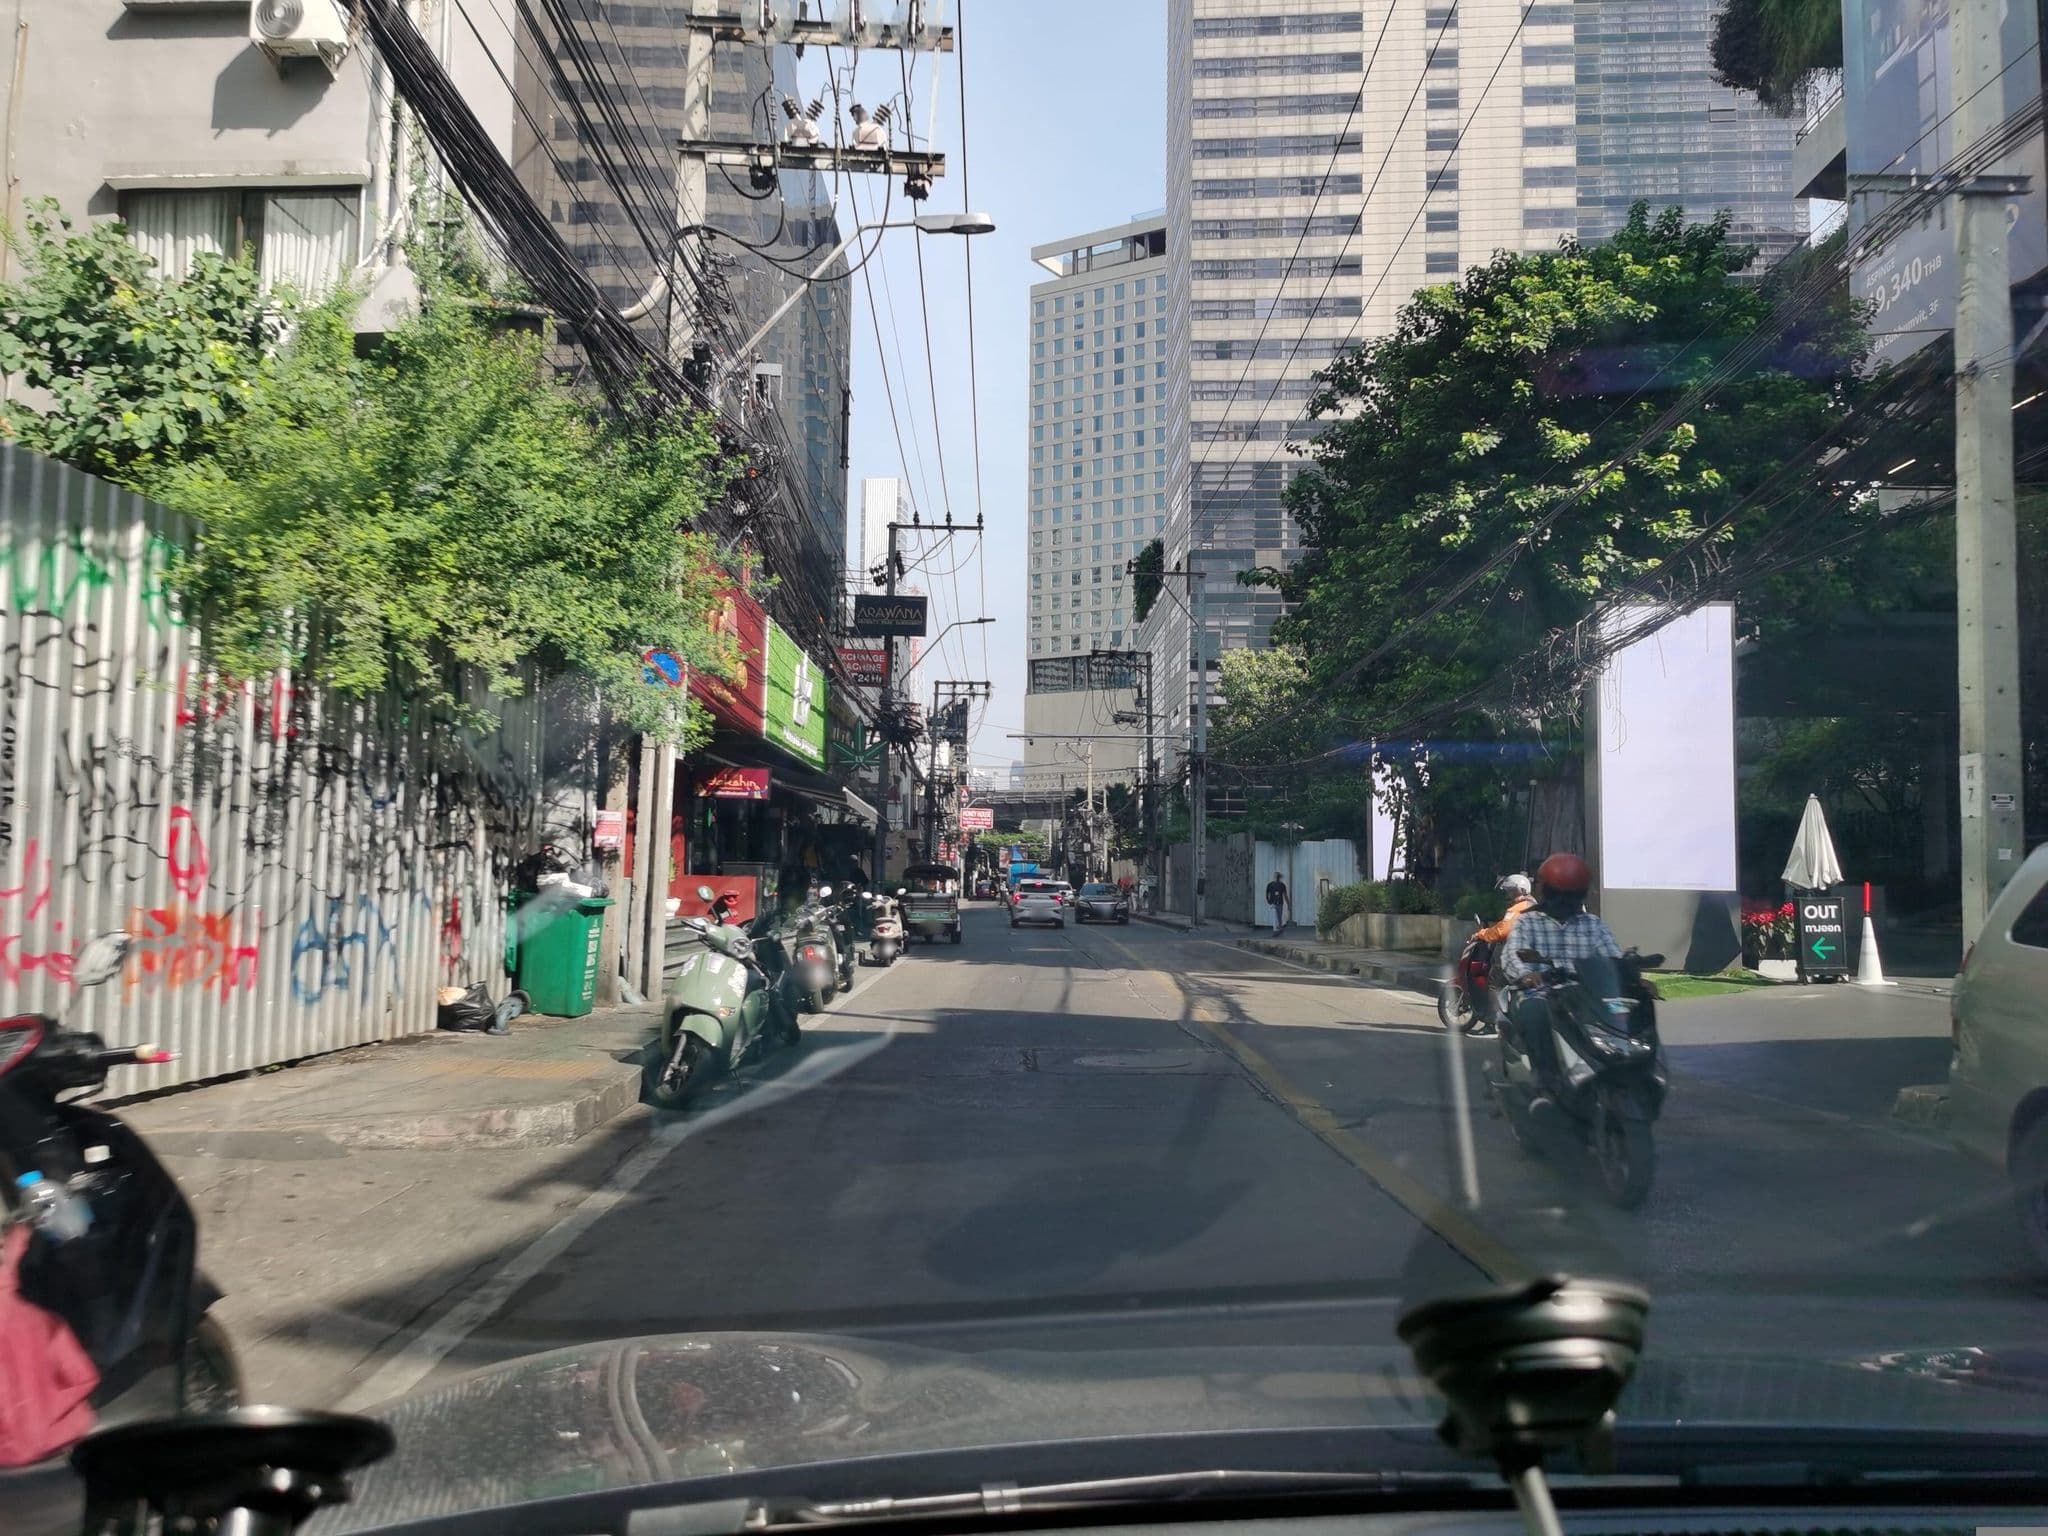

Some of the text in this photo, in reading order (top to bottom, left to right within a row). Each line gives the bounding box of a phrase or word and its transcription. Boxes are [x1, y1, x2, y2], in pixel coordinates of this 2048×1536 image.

[1923, 255, 1942, 277] THB
[857, 604, 922, 620] ARAWANA
[839, 653, 886, 663] XCHANGE
[844, 661, 882, 672] ACHINE
[1804, 904, 1838, 919] OUT
